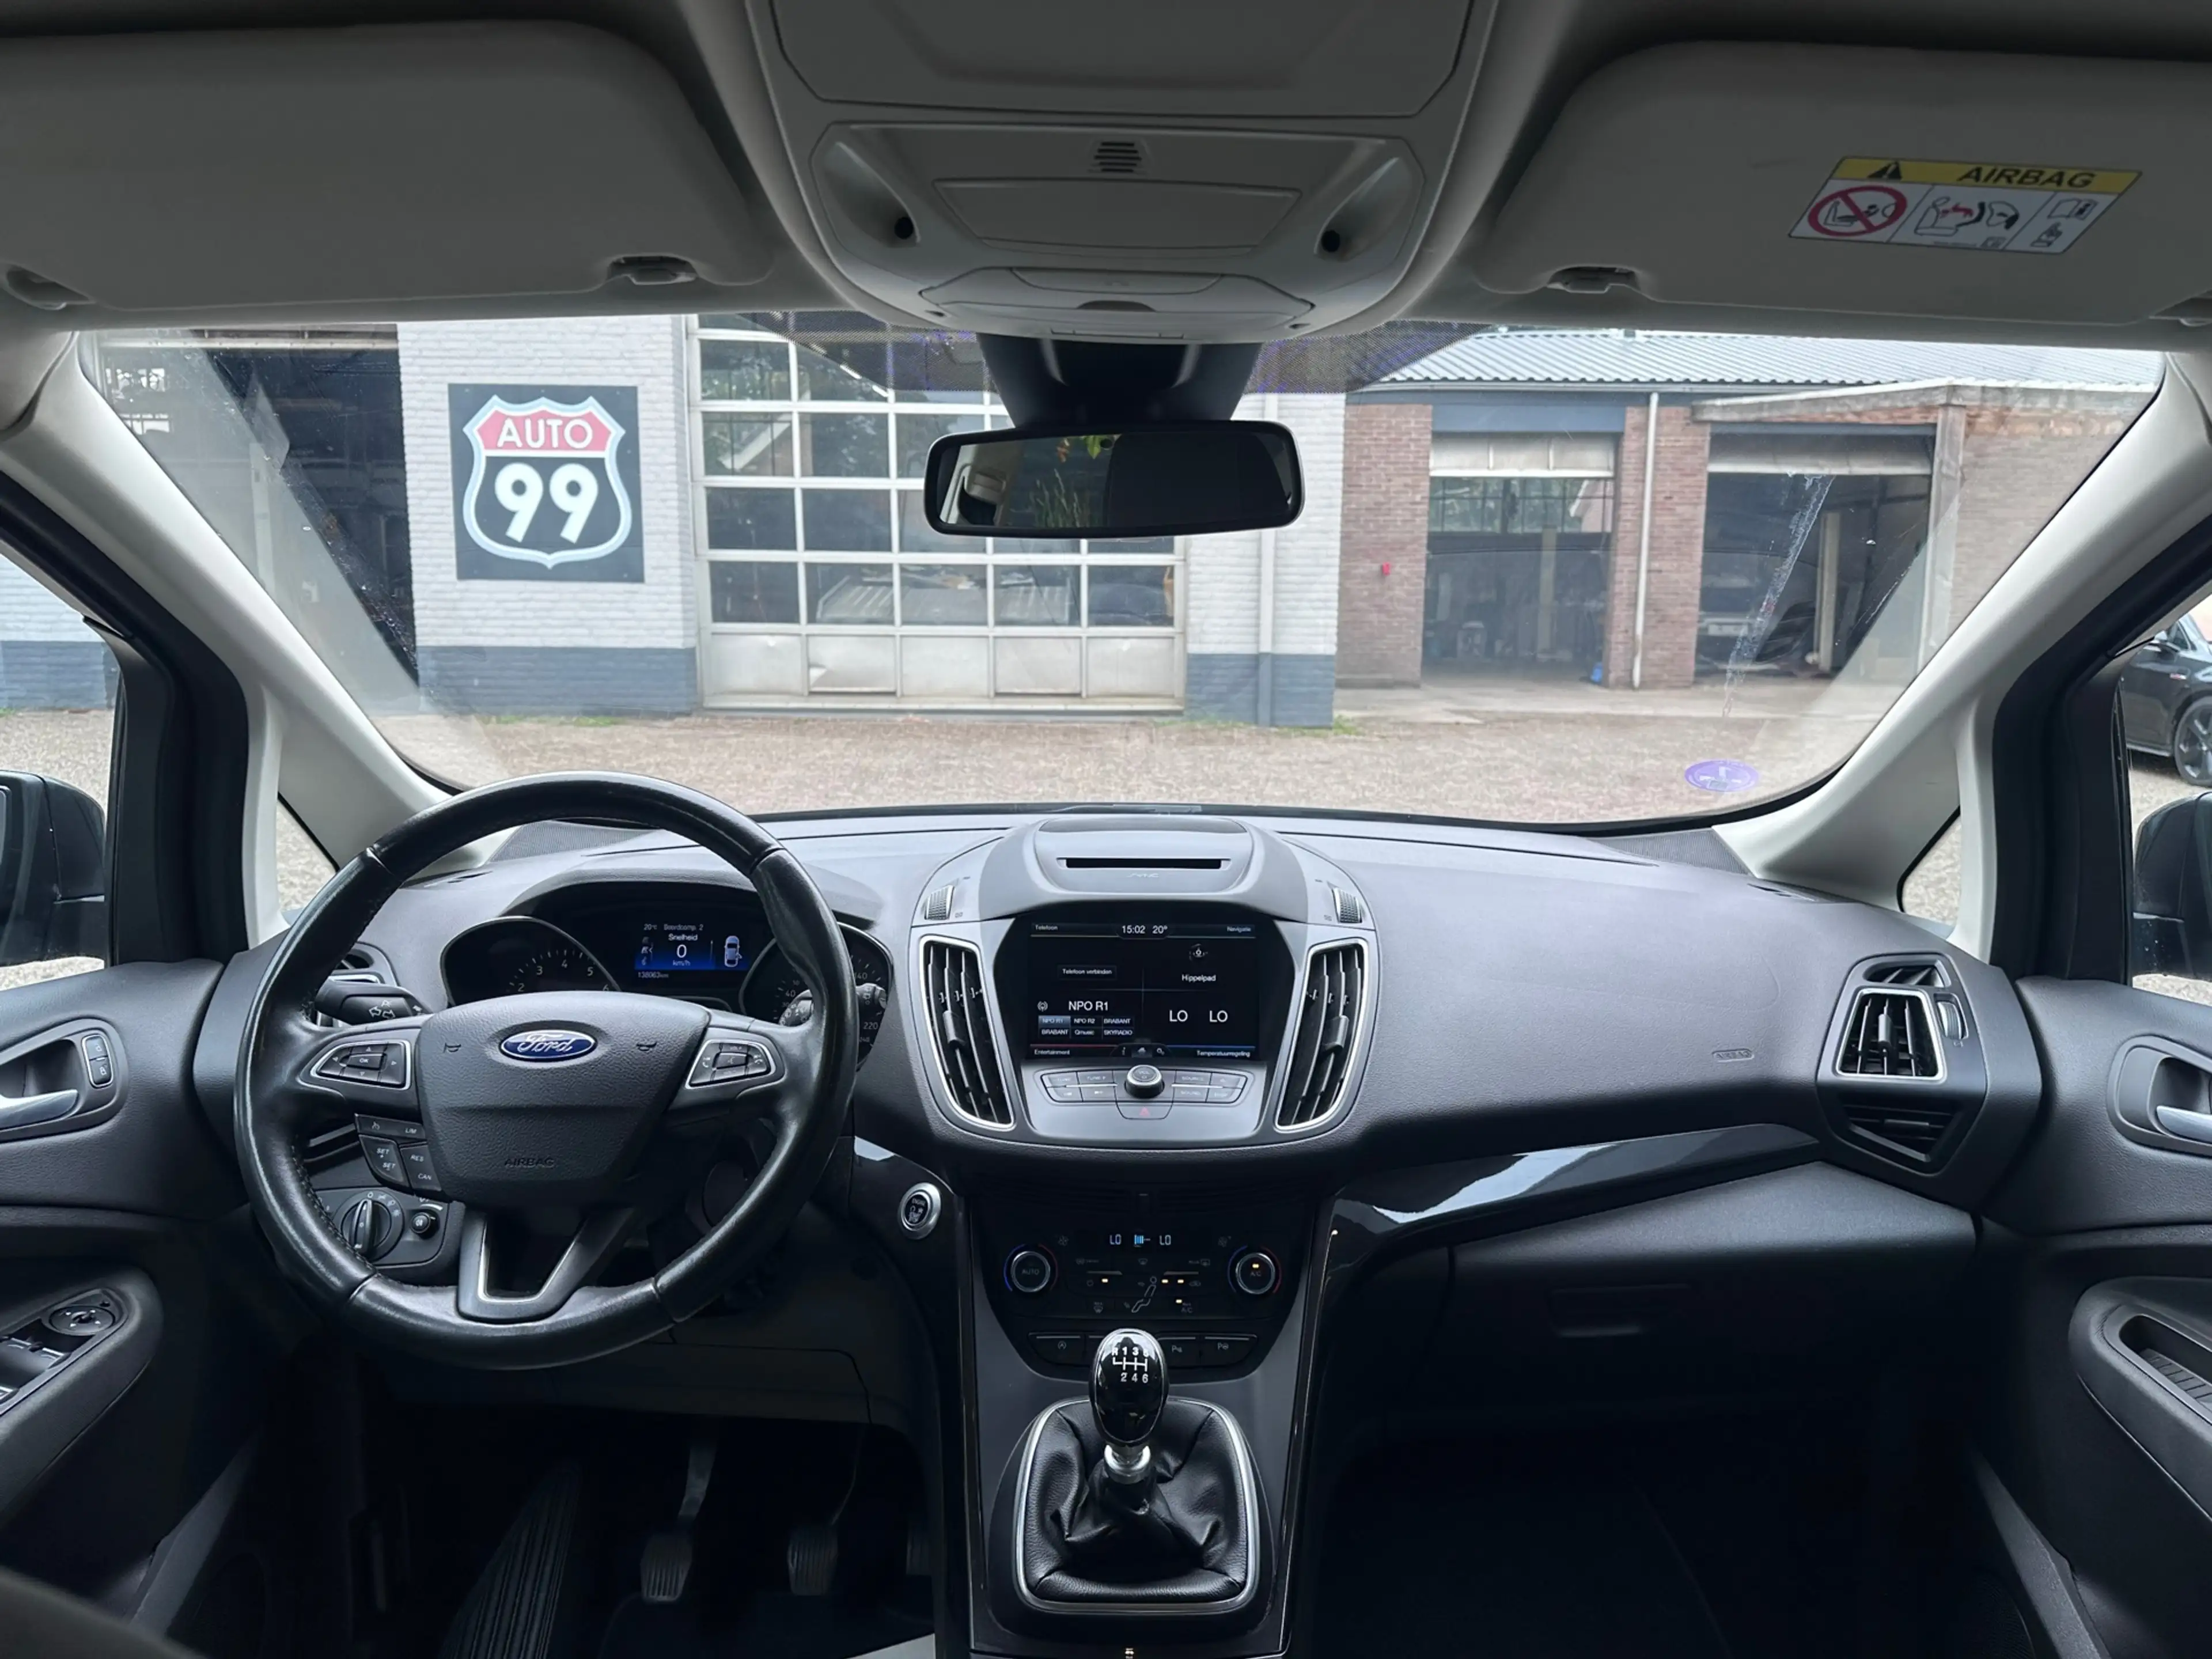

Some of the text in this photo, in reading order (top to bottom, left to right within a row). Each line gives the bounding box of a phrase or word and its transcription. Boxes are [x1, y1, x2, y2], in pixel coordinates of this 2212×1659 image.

[1955, 165, 2097, 190] AIRBAG
[497, 418, 593, 449] AUTO
[494, 462, 599, 544] 99
[1122, 925, 1168, 934] 15:02 20°
[668, 933, 698, 941] Snelheid
[676, 944, 688, 959] 0
[561, 959, 568, 968] 4
[536, 966, 543, 975] 3
[587, 967, 594, 976] 5
[1181, 974, 1217, 983] Hippelpad
[517, 983, 525, 992] 2
[785, 990, 796, 998] 40
[1069, 1001, 1108, 1011] NPO R1
[1169, 1009, 1228, 1023] LO LO
[863, 1022, 878, 1030] 220
[517, 1033, 576, 1053] Ford
[376, 1147, 390, 1155] SET
[410, 1154, 425, 1162] RES
[505, 1157, 555, 1169] AIRBAG
[418, 1172, 432, 1180] CAN
[1109, 1233, 1172, 1245] LO LO
[1111, 1346, 1119, 1356] R
[1122, 1346, 1128, 1356] 1
[1132, 1346, 1139, 1356] 3
[1120, 1372, 1149, 1384] 2 4 6
